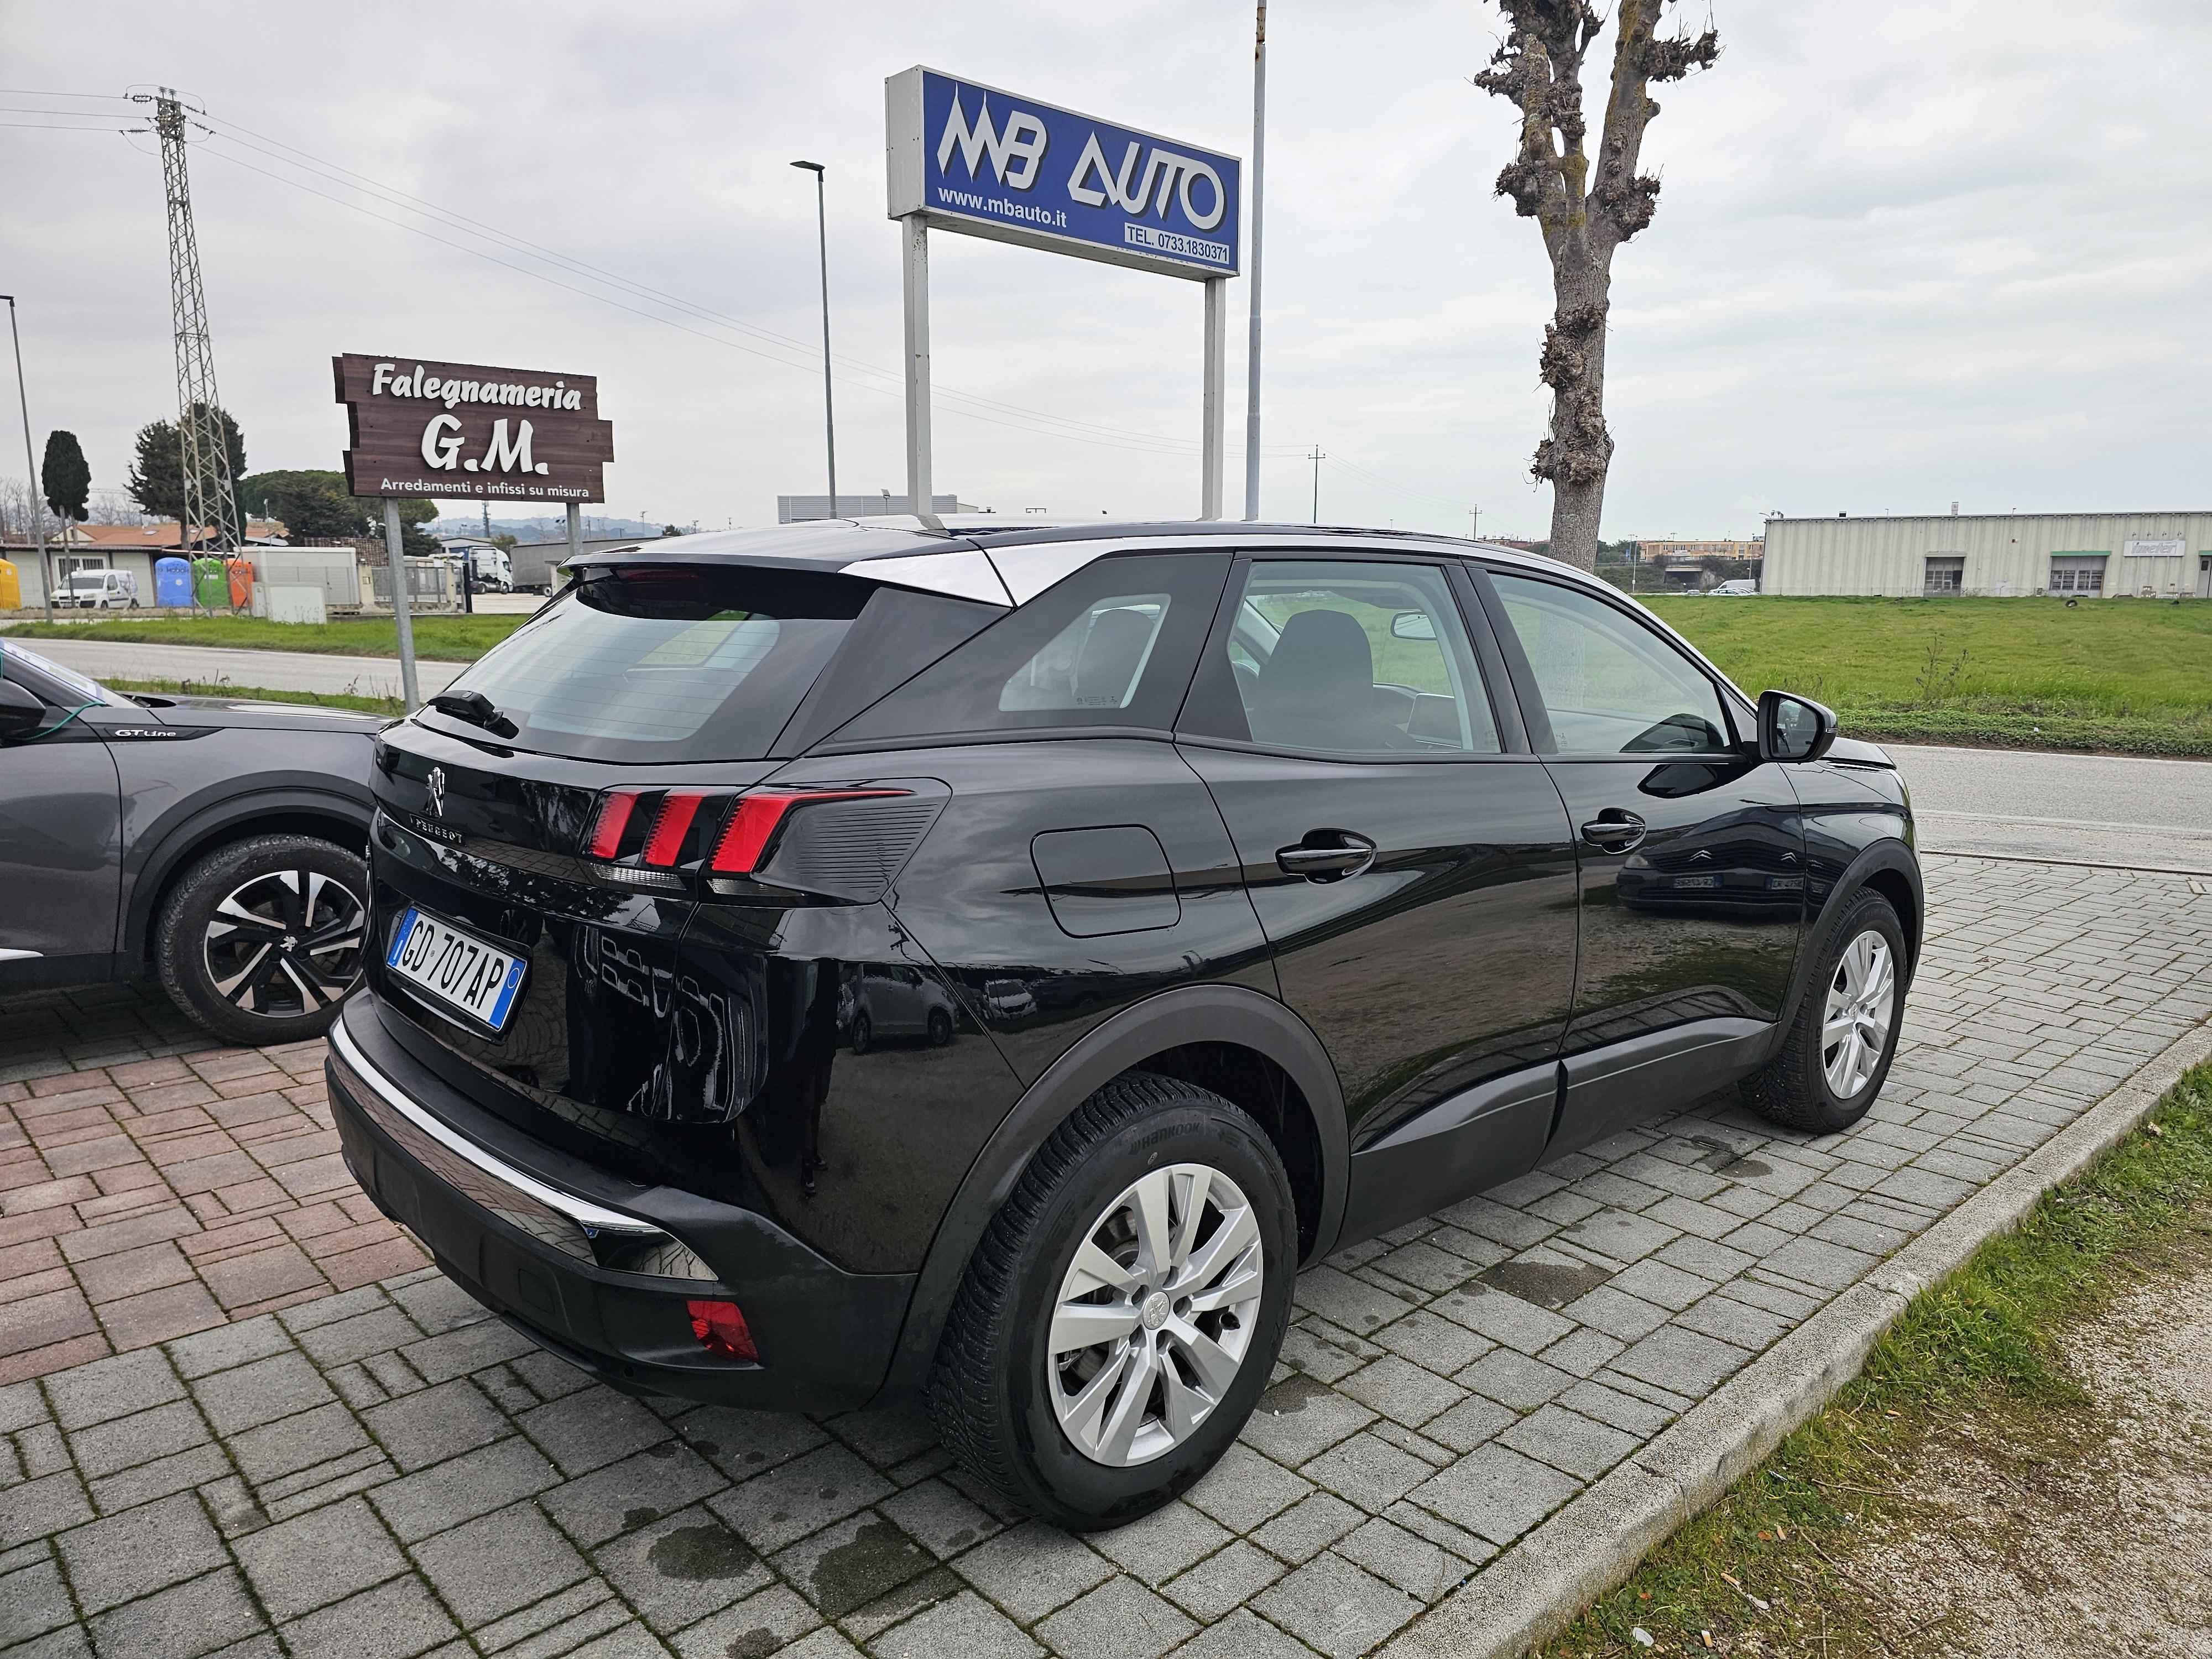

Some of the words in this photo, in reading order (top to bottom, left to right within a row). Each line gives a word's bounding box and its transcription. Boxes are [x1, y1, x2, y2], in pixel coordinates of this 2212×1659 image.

[937, 81, 1048, 191] MB
[1067, 129, 1226, 232] AUTO
[937, 187, 1067, 228] www.mbauto.it
[1127, 226, 1154, 247] TEL.
[1157, 233, 1228, 262] 0733.1830371
[372, 363, 581, 410] Falegnameria
[421, 414, 549, 476] G.M.
[380, 478, 471, 493] Arredamenti
[475, 484, 483, 493] e
[487, 482, 525, 495] infissi
[529, 486, 544, 496] su
[547, 485, 589, 498] misura
[416, 818, 462, 843] PEUGEOT
[402, 920, 435, 972] GD
[427, 933, 504, 1010] 707AP
